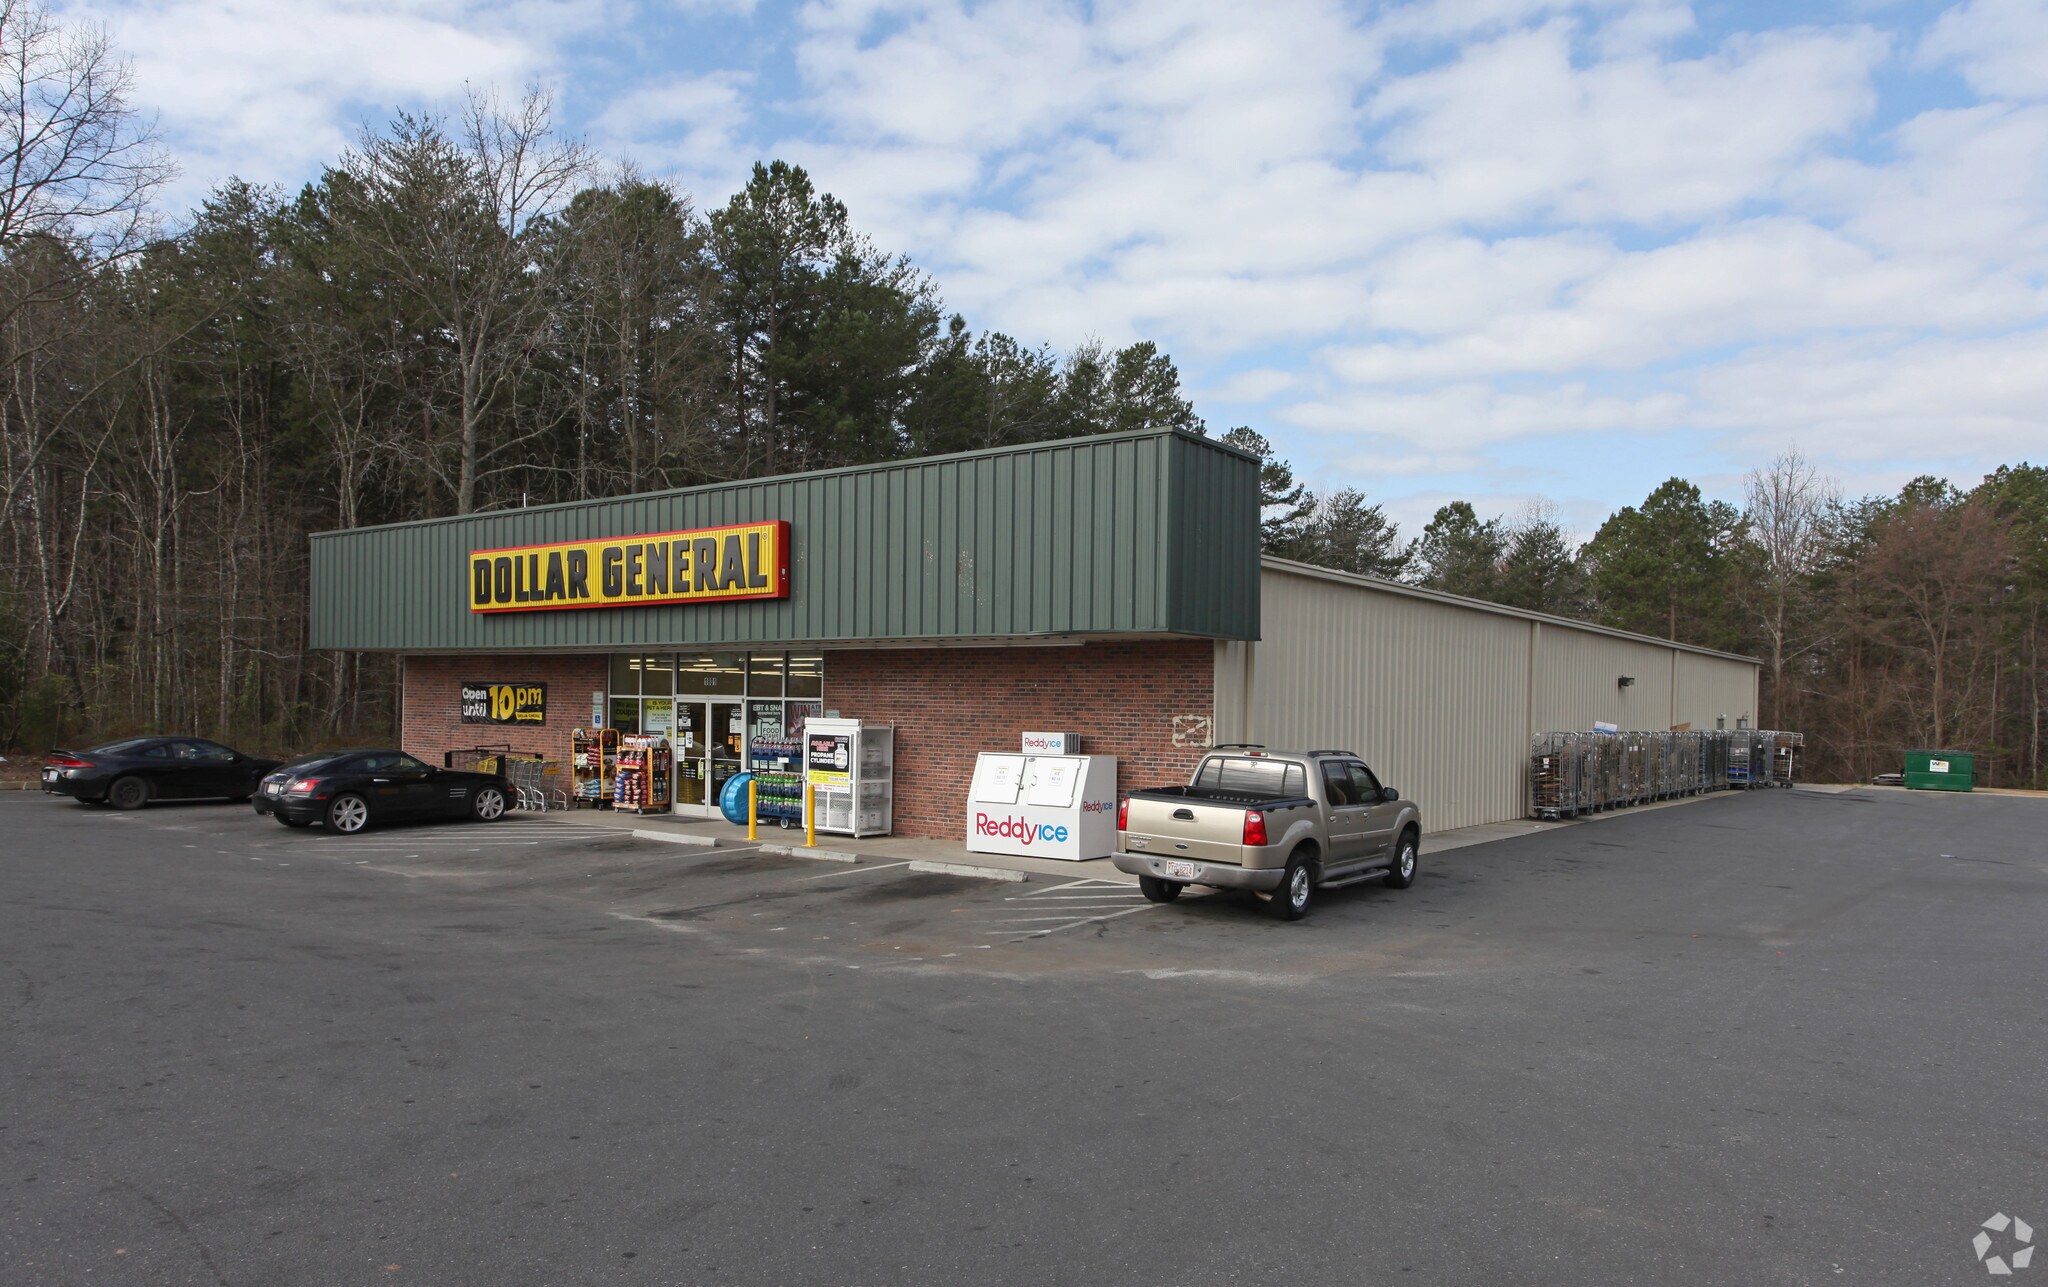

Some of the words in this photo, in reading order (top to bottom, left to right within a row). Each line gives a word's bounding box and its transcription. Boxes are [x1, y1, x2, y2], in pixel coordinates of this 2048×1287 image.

[473, 548, 591, 605] DOLLAR
[601, 531, 768, 598] GENERAL
[462, 687, 487, 701] Open
[462, 702, 487, 717] until
[489, 685, 515, 720] 10
[516, 687, 543, 709] pm
[790, 704, 811, 719] WIN
